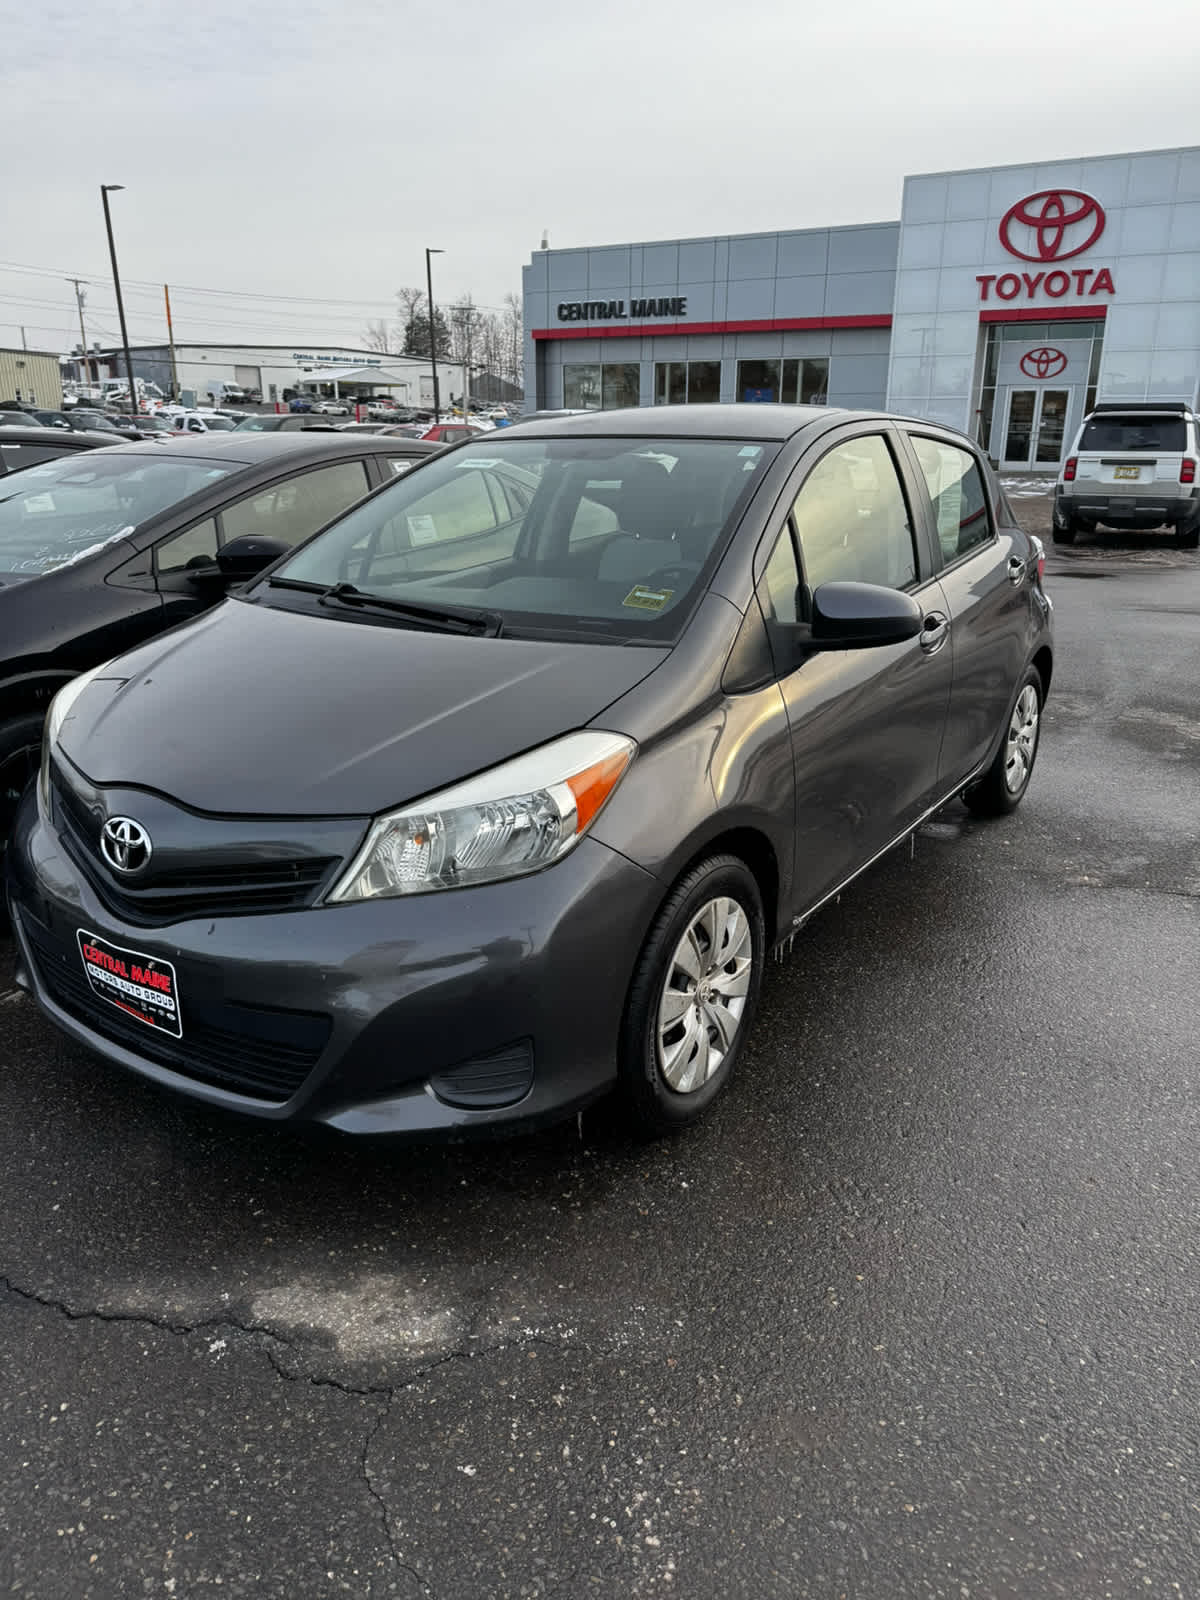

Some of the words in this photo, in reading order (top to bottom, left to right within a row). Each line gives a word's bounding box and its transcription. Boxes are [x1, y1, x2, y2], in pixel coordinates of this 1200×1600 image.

[976, 268, 1115, 300] TOYOTA
[557, 301, 628, 321] CENTRAL
[630, 297, 687, 317] MAINE
[83, 943, 129, 978] CENTRAL
[131, 965, 171, 993] MAINE
[88, 964, 119, 987] MOTORS
[119, 980, 142, 998] AUTO
[143, 990, 174, 1008] GROUP
